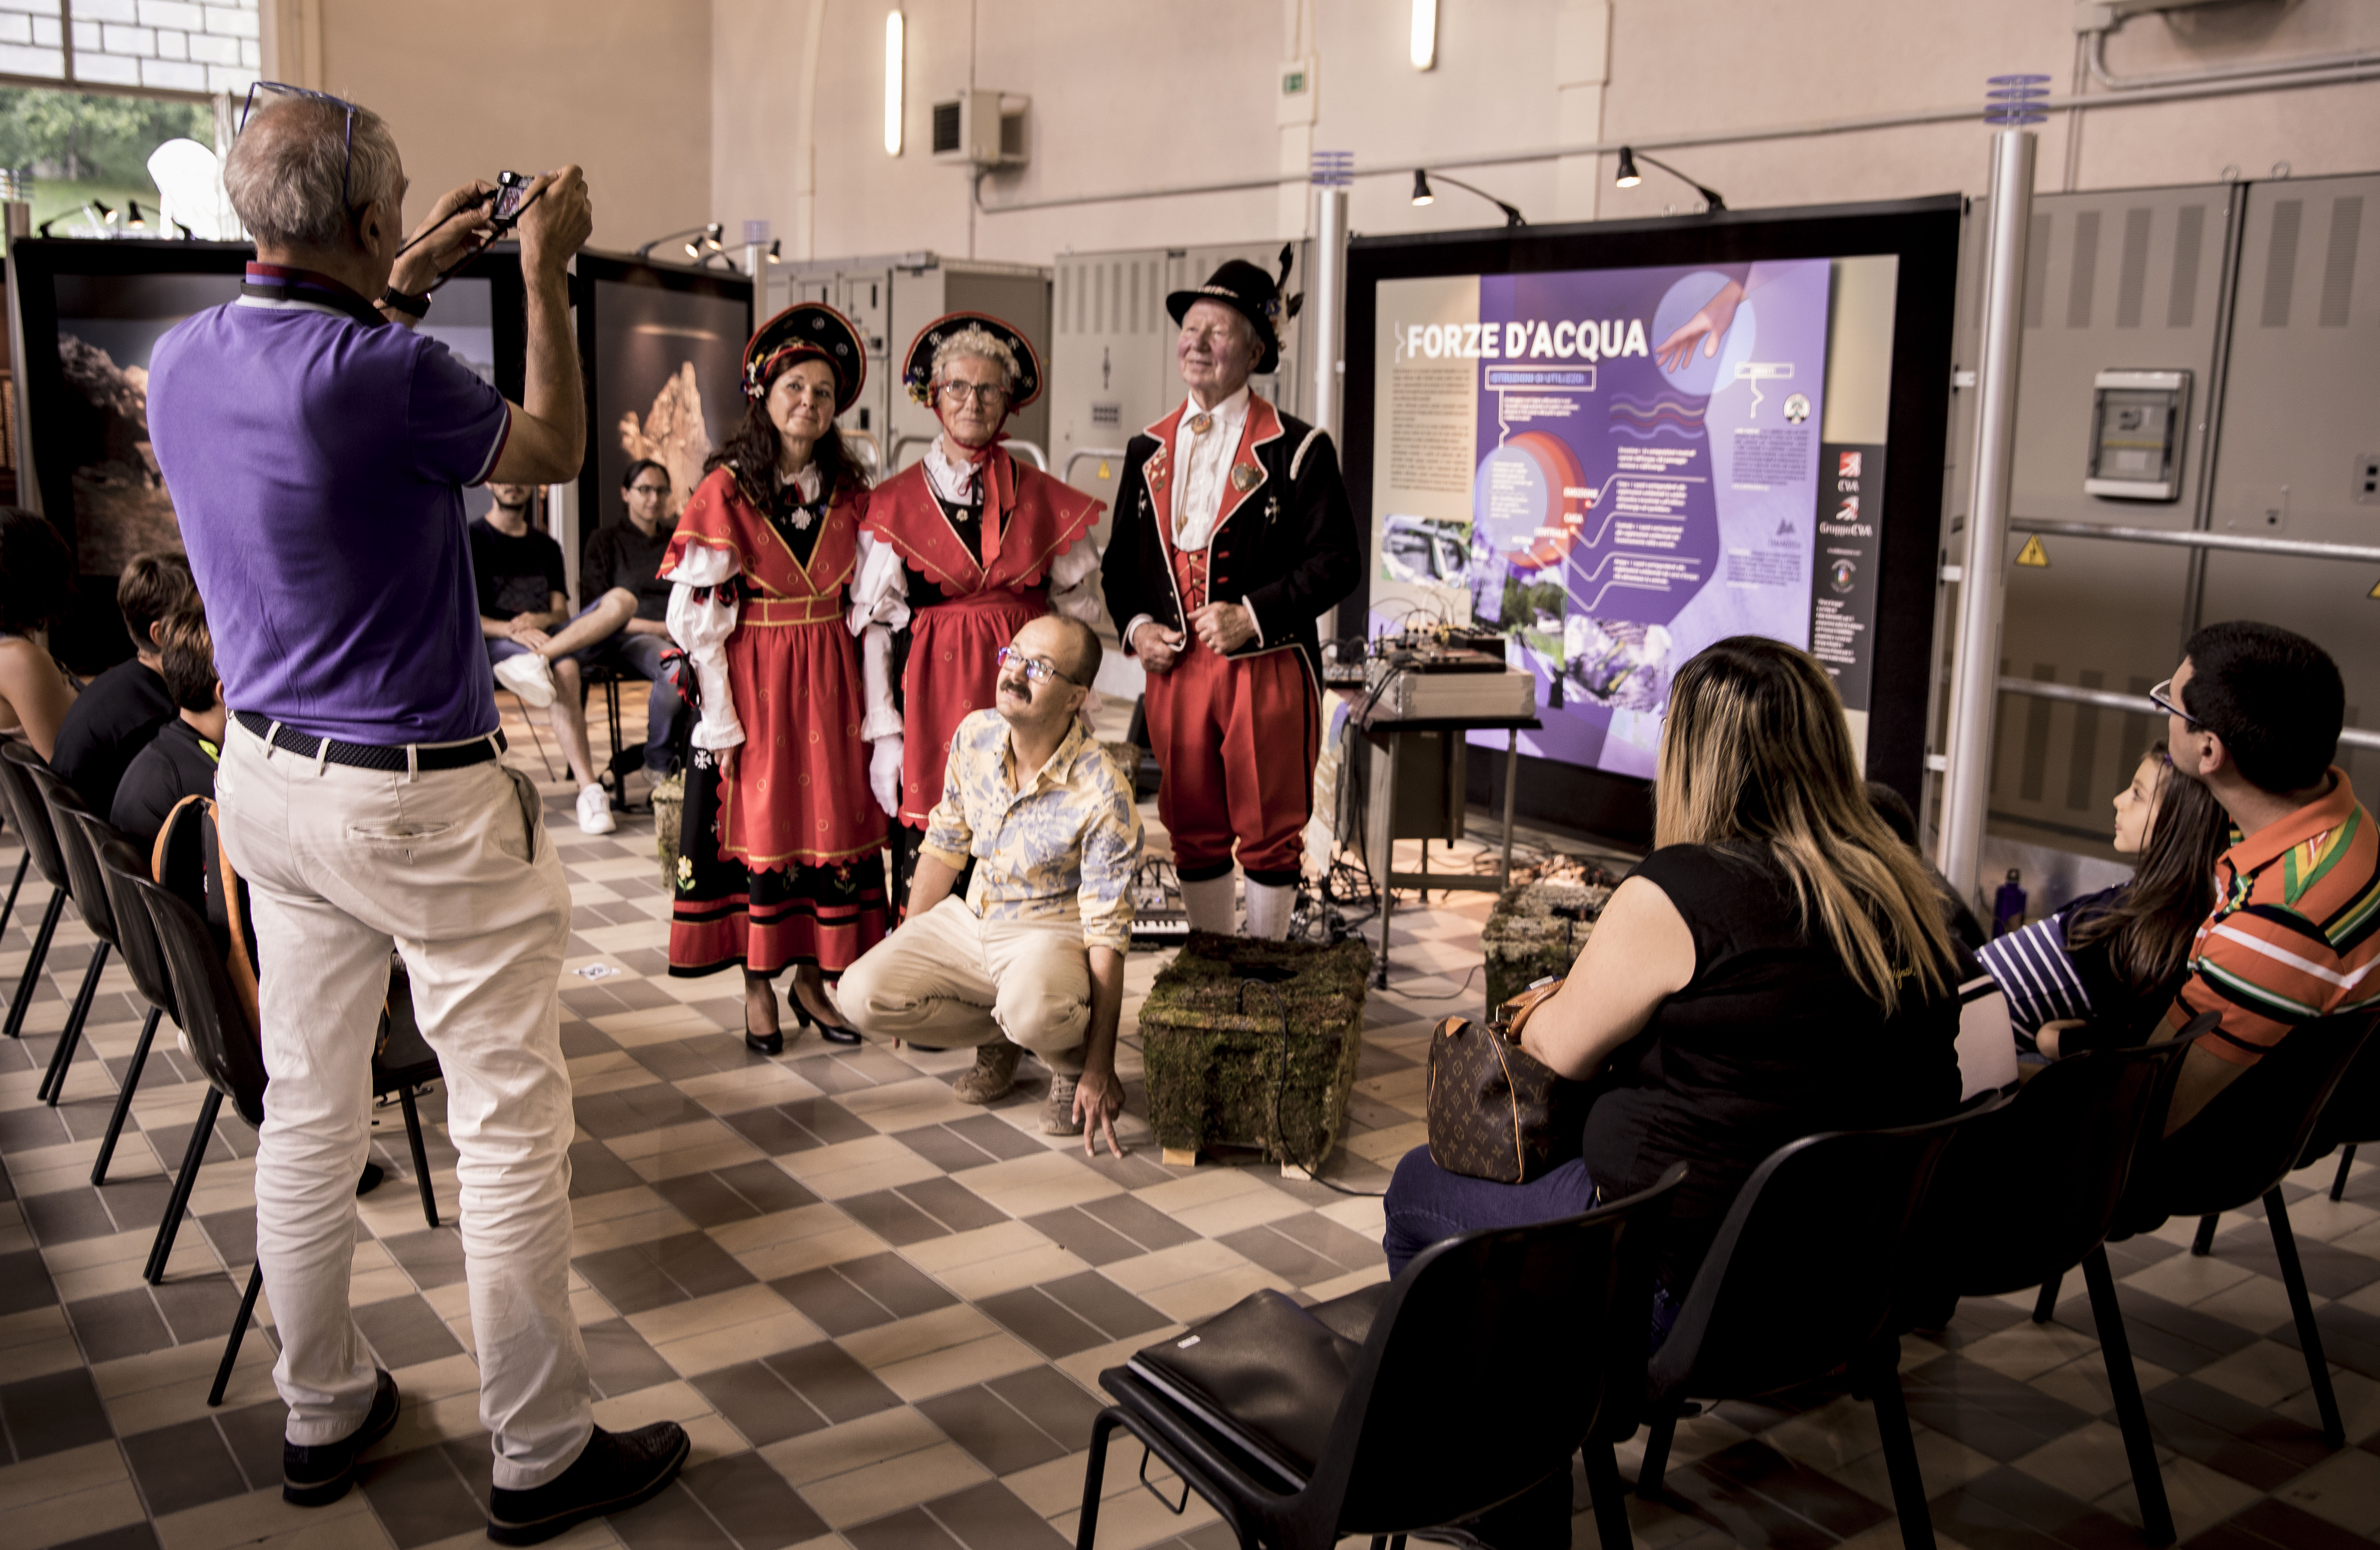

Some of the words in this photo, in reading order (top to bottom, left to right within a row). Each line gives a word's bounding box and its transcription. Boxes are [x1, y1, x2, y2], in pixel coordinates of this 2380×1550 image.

[1407, 323, 1500, 358] FORZE
[1505, 319, 1649, 363] D'ACQUA
[1838, 479, 1860, 493] CVA
